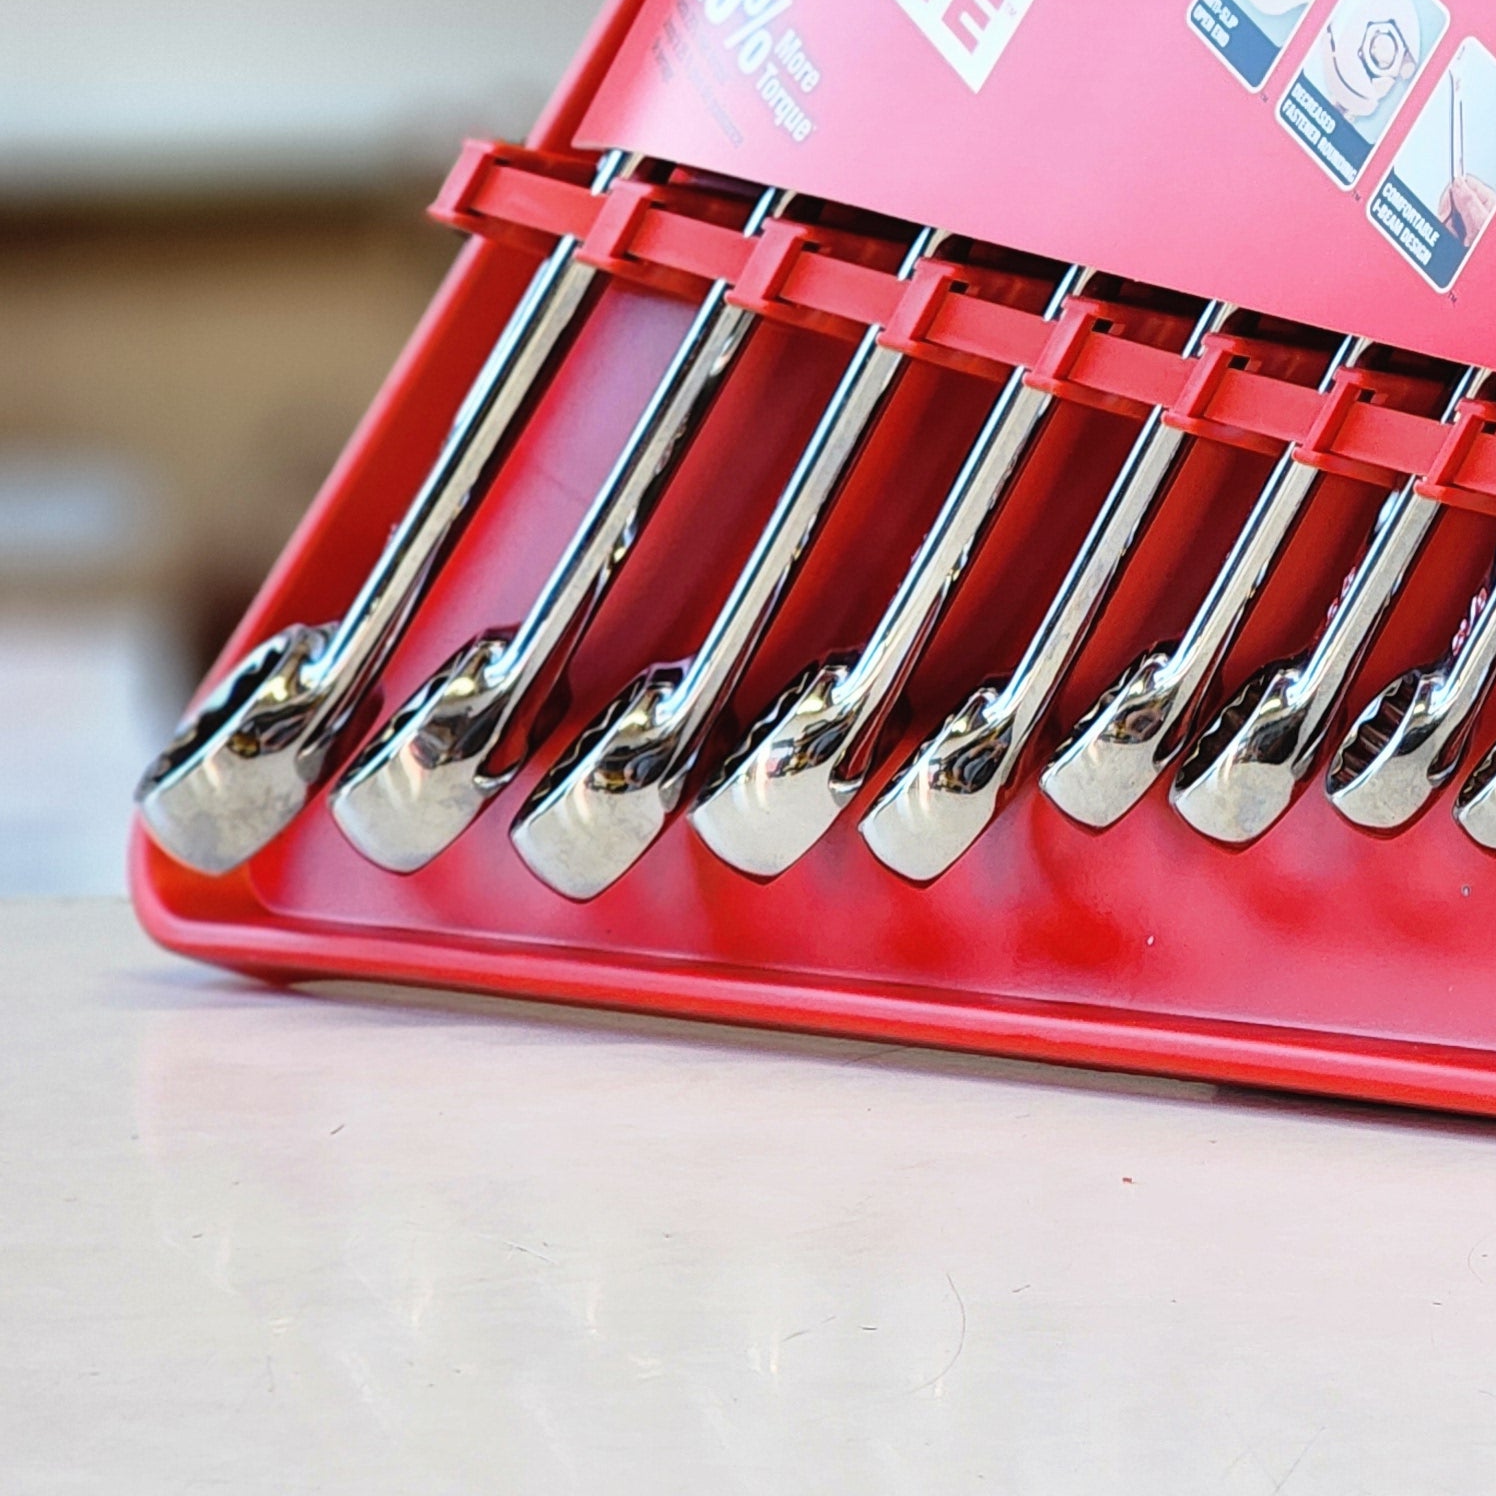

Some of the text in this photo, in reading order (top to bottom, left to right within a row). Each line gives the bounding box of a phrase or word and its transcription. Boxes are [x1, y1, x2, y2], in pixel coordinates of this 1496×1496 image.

[773, 28, 821, 94] More
[1281, 98, 1322, 146] FASTENER
[1291, 83, 1336, 135] DECREASED
[1382, 183, 1441, 248] COMFORTABLE
[1399, 226, 1432, 266] DESIGN
